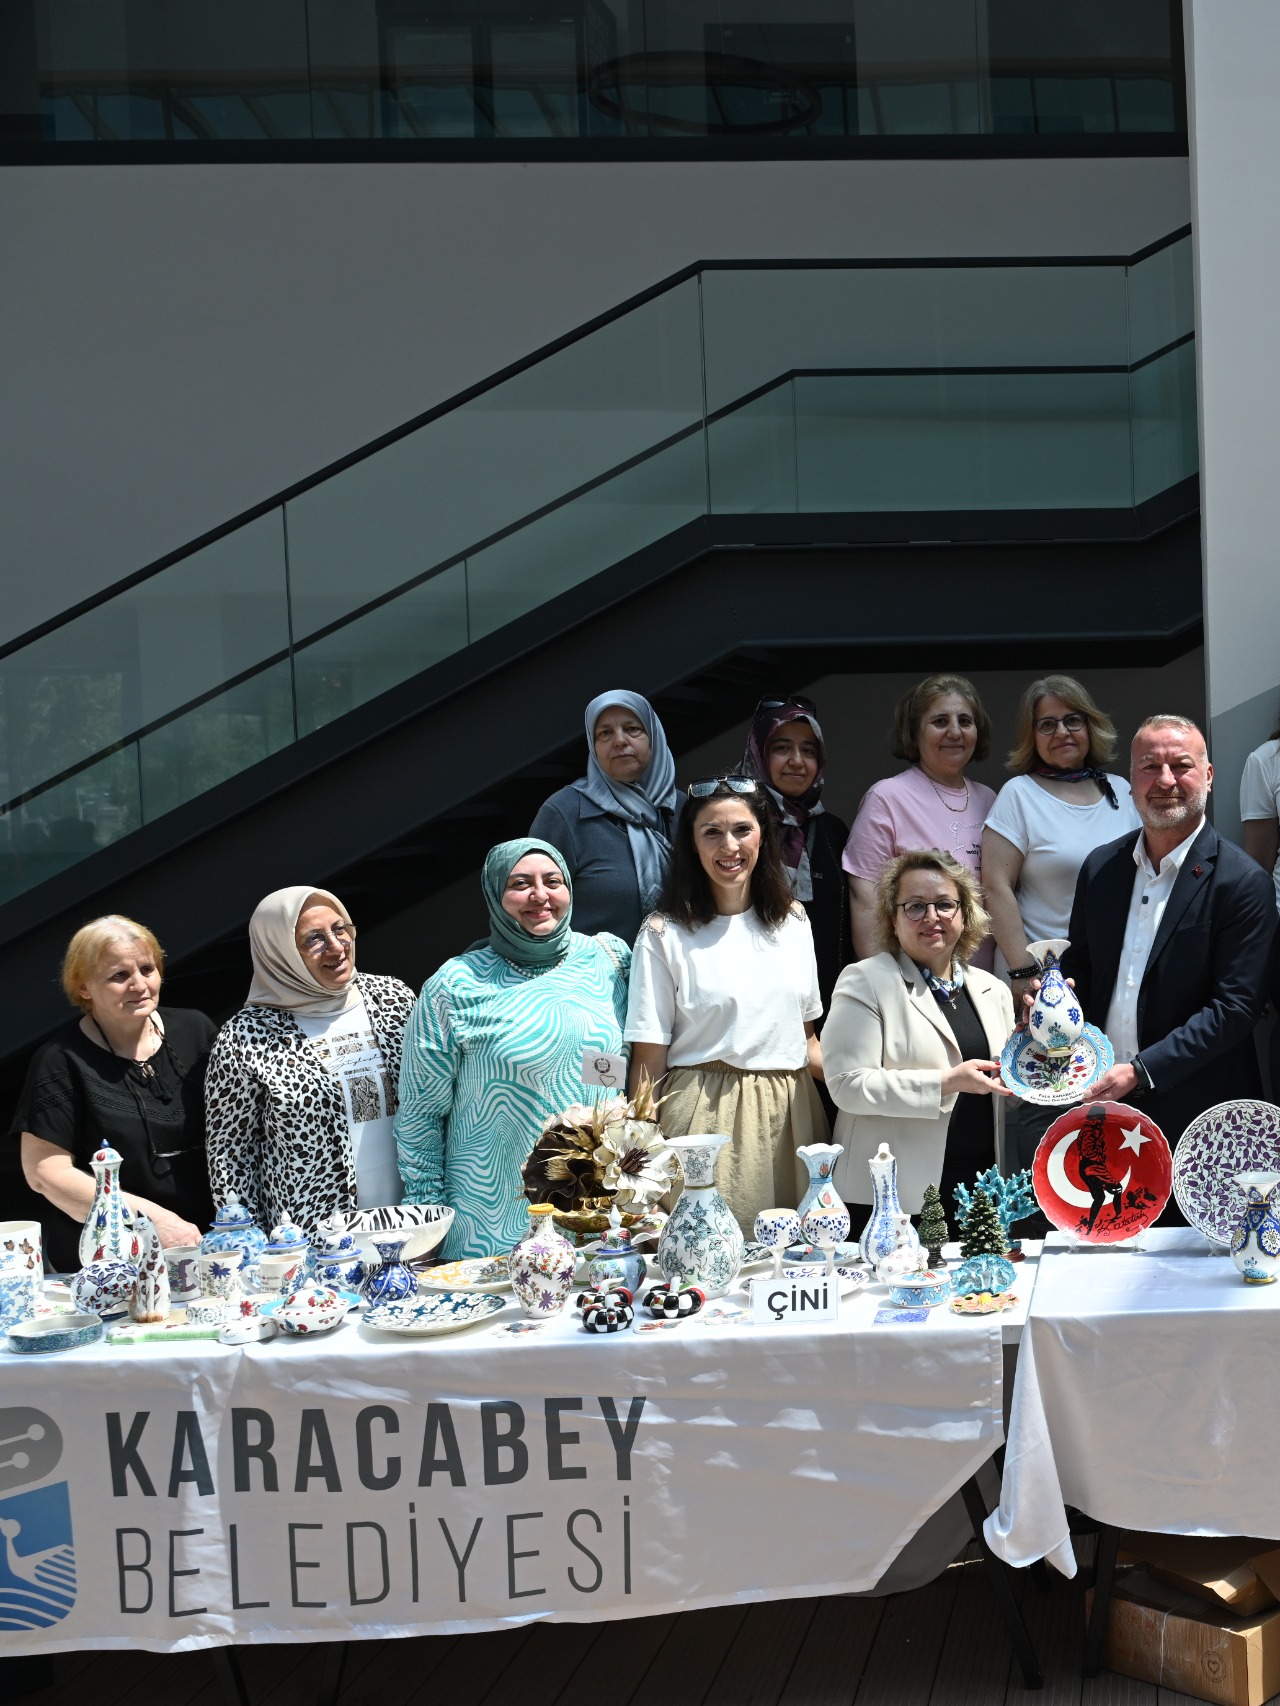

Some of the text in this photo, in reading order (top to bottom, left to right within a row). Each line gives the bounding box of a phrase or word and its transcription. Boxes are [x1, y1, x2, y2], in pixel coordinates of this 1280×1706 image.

[767, 1282, 828, 1321] ÇİNİ
[105, 1395, 647, 1499] KARACABEY
[115, 1495, 633, 1619] BELEDİYESİ
